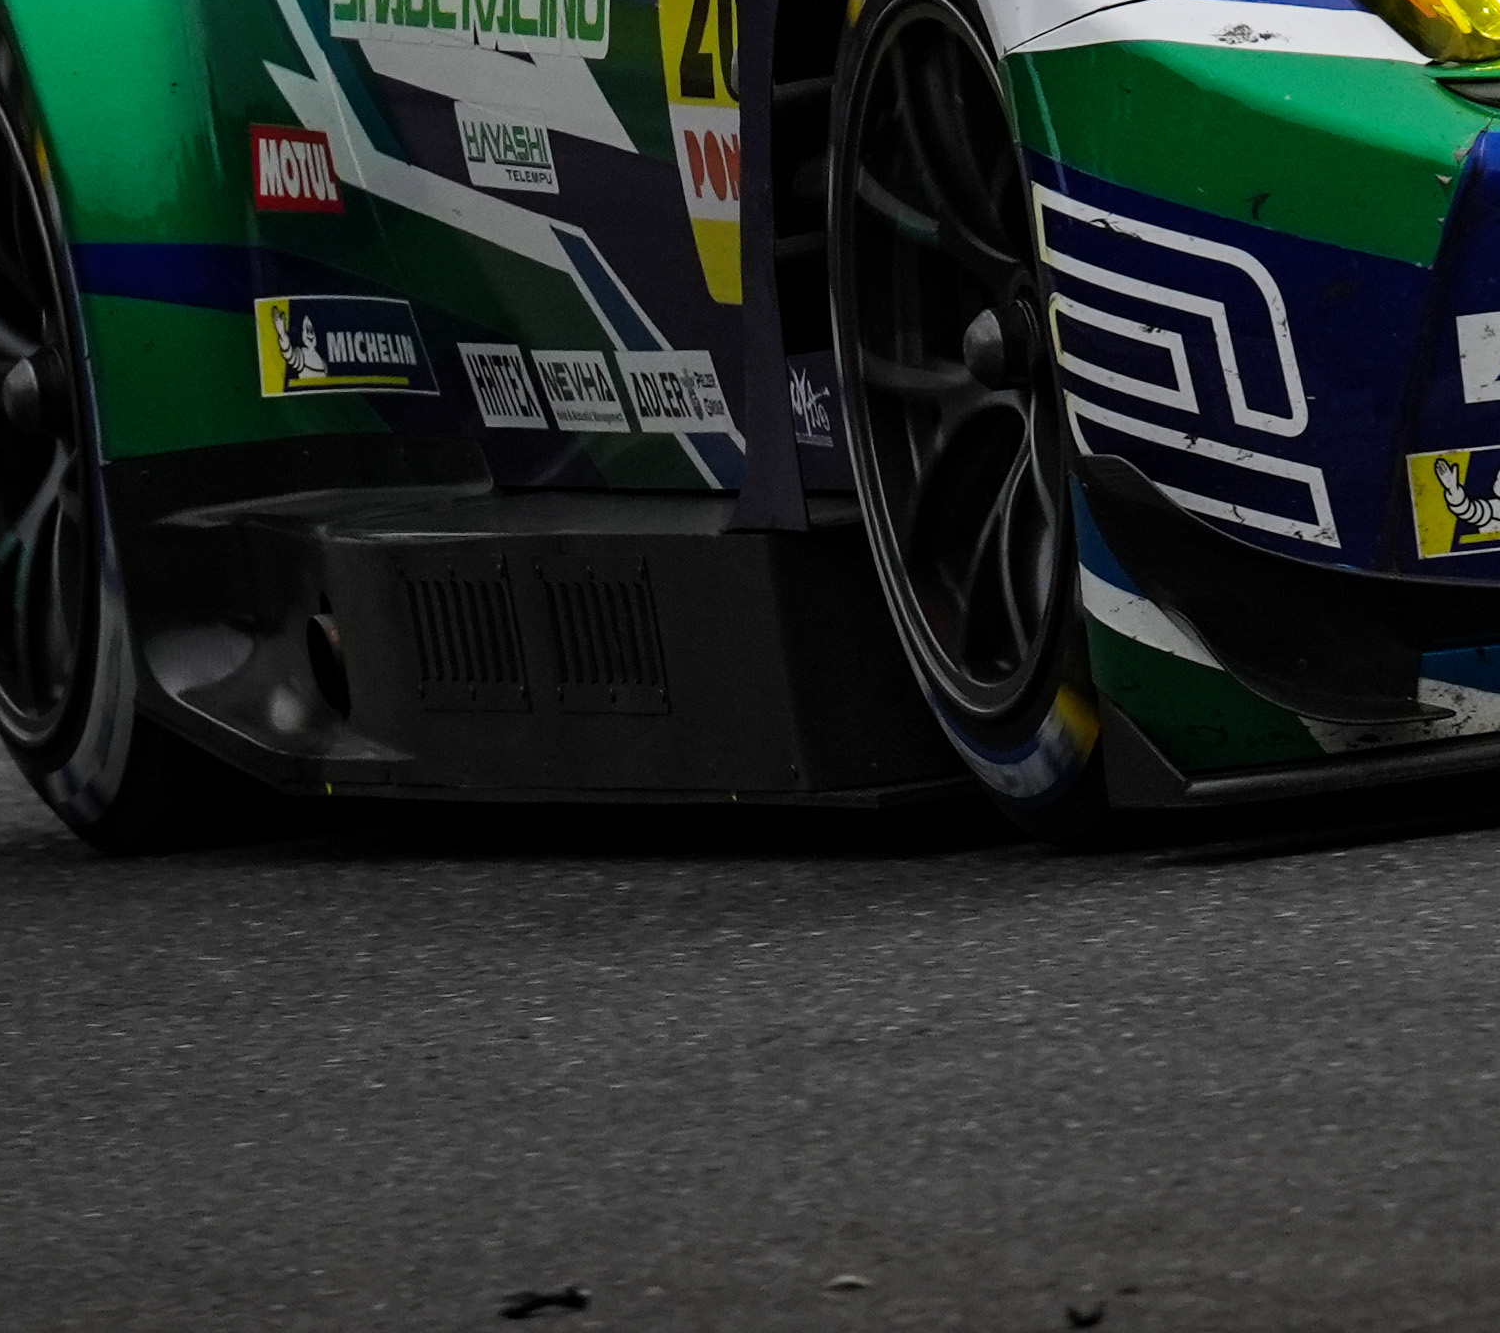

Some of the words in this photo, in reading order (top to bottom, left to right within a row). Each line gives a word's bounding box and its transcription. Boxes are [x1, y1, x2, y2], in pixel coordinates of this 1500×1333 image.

[461, 120, 552, 169] HAYASHI
[258, 137, 339, 202] MOTUL
[504, 169, 553, 185] TELEMPU
[326, 330, 418, 367] MICHELIN
[466, 353, 542, 418] HAITEX
[537, 360, 617, 402] NEVHA
[629, 370, 692, 419] ADLER
